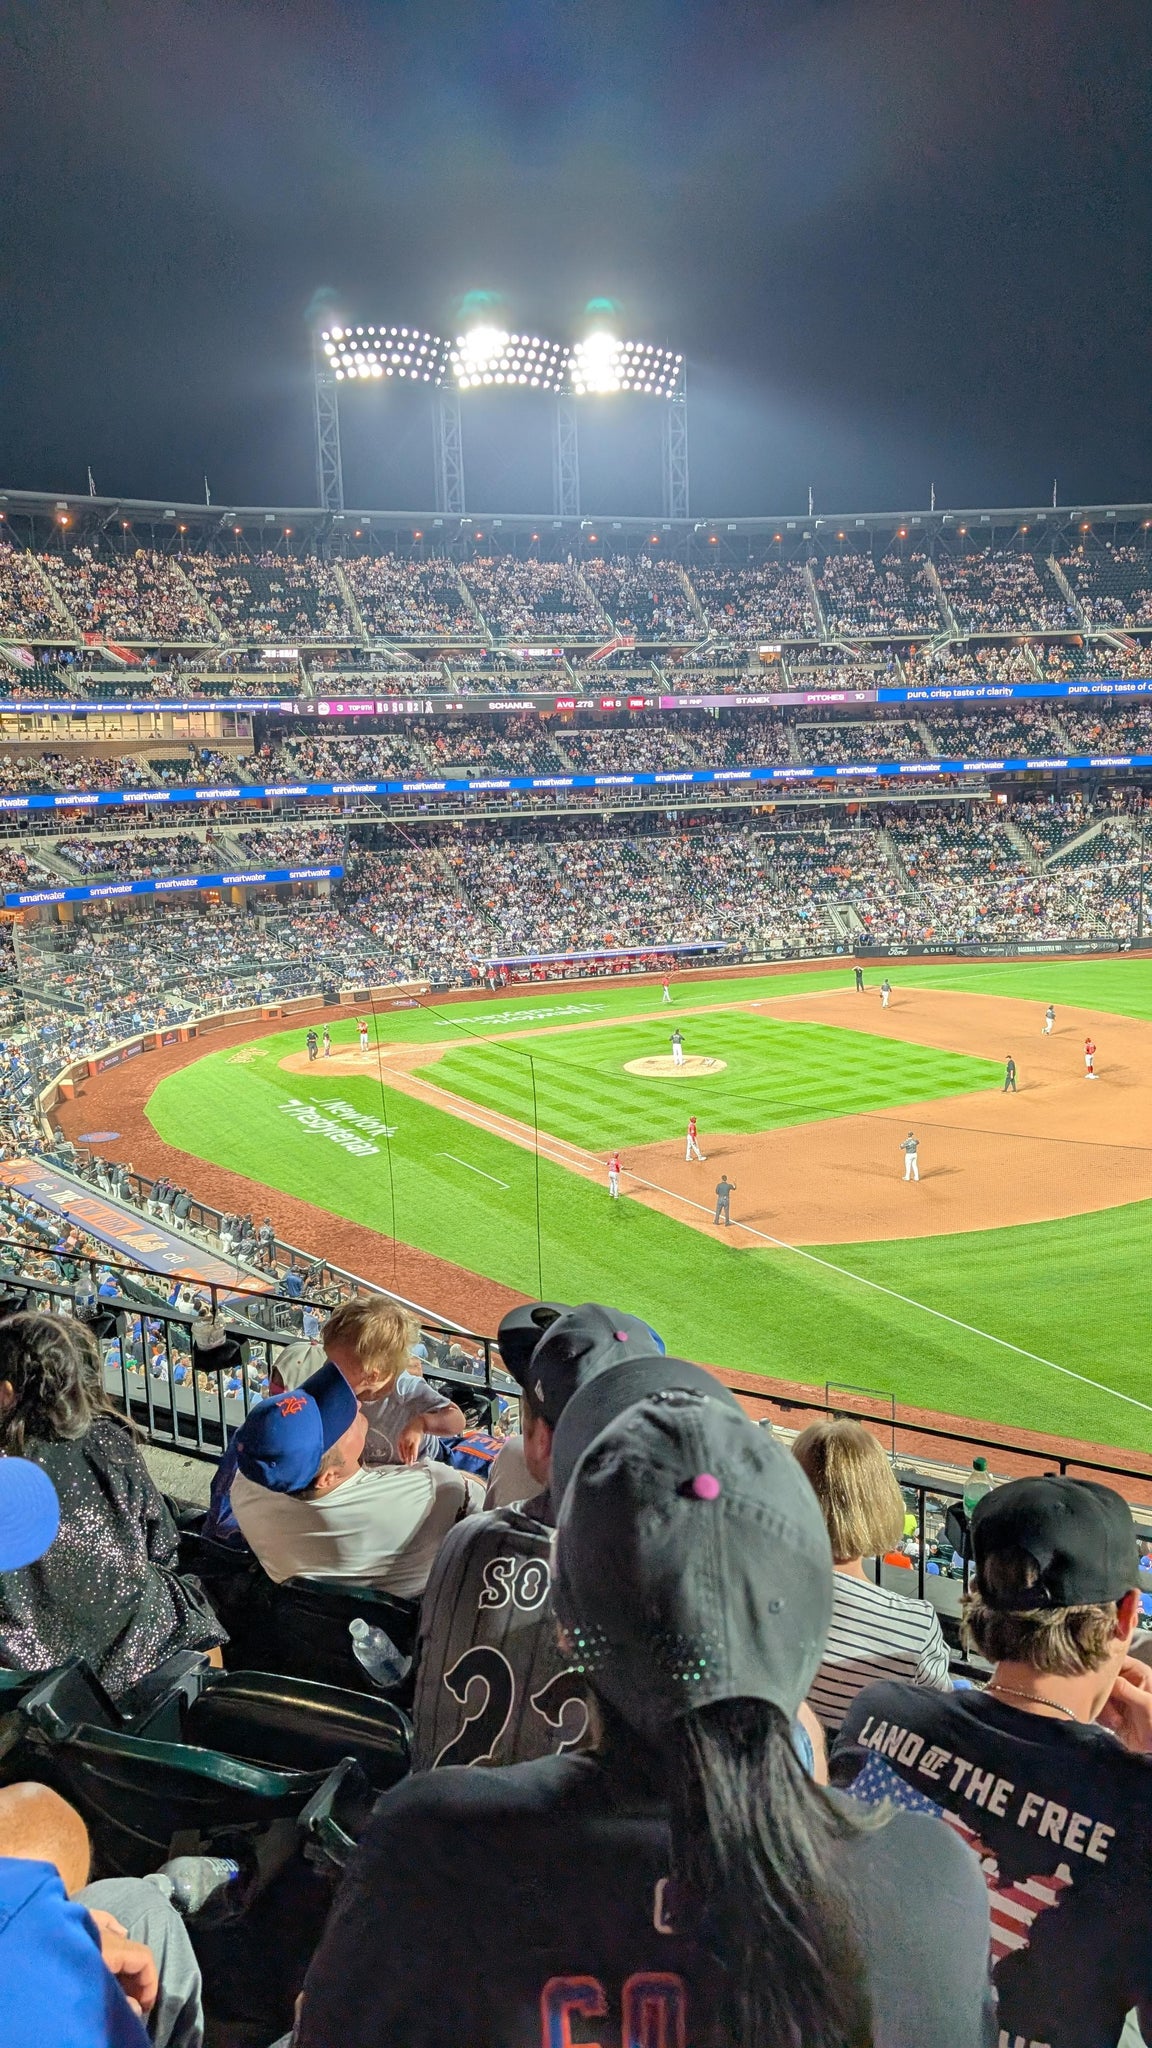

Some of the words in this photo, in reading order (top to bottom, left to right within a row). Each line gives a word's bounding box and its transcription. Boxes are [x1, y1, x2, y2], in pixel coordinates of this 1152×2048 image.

[1068, 686, 1090, 694] pure,
[1091, 684, 1113, 693] crisp
[1114, 684, 1136, 692] taste
[1137, 682, 1147, 690] of
[907, 691, 929, 700] pure,
[930, 689, 952, 699] crisp
[953, 688, 975, 697] taste
[975, 687, 986, 696] of
[986, 687, 1014, 697] clarity
[807, 694, 845, 702] PITCHES
[488, 702, 536, 710] SCHANUEL
[556, 700, 575, 709] AVG
[575, 700, 594, 708] .278
[602, 699, 615, 708] HR
[336, 704, 344, 712] 3
[964, 762, 1004, 770] smartwater
[1028, 760, 1067, 768] smartwater
[1091, 758, 1131, 766] smartwater
[774, 769, 814, 777] smartwater
[837, 767, 877, 775] smartwater
[596, 776, 633, 784] smartwater
[656, 774, 693, 782] smartwater
[470, 781, 510, 789] smartwater
[533, 778, 572, 787] smartwater
[333, 785, 376, 793] smartwater
[403, 783, 445, 791] smartwater
[196, 790, 240, 798] smartwater
[265, 787, 307, 796] smartwater
[55, 795, 98, 805] smartwater
[123, 793, 170, 802] smartwater
[290, 870, 330, 878] smartwater
[223, 875, 265, 883] smartwater
[156, 880, 197, 888] smartwater
[90, 886, 132, 895] smartwater
[20, 892, 65, 902] smartwater
[888, 946, 909, 956] Ford
[280, 1106, 380, 1157] Presbyterian
[46, 1189, 84, 1205] THE
[162, 1252, 189, 1264] citi
[467, 1436, 504, 1451] Met
[478, 1557, 551, 1611] SO
[857, 1716, 926, 1768] LAND
[918, 1745, 953, 1779] OF
[948, 1753, 1016, 1819] THE
[1016, 1791, 1116, 1864] FREE
